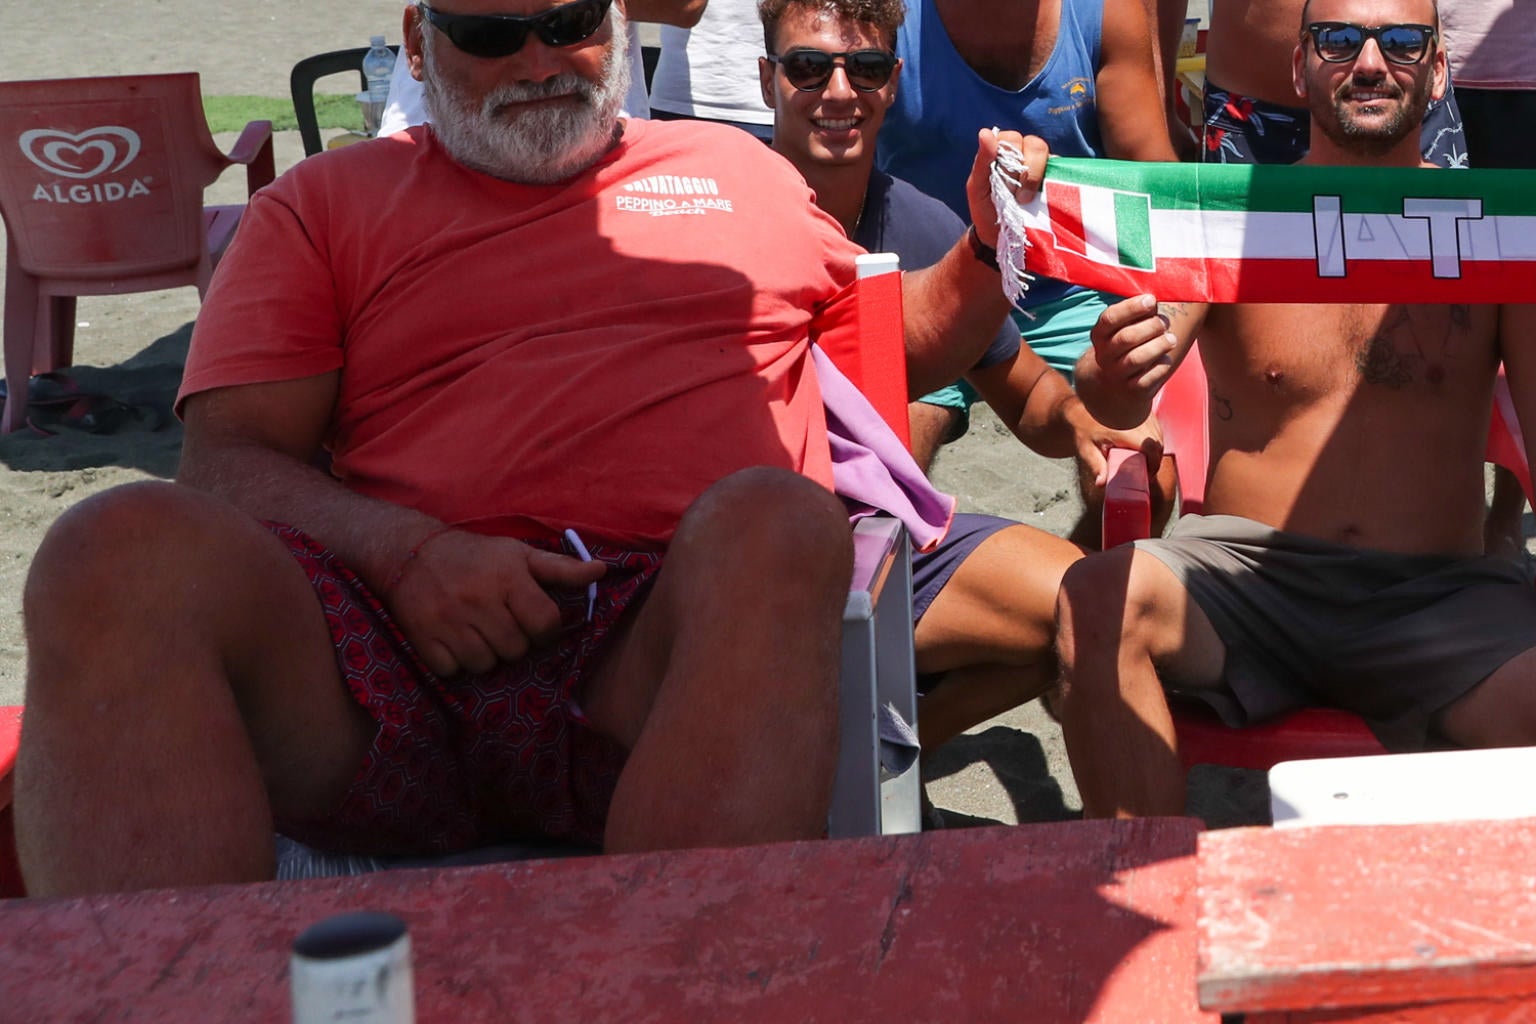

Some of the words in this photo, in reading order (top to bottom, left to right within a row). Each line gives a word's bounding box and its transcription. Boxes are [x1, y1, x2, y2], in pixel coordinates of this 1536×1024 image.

[32, 178, 151, 203] ALGIDA
[616, 196, 676, 211] PEPPINO
[693, 198, 733, 211] MARE
